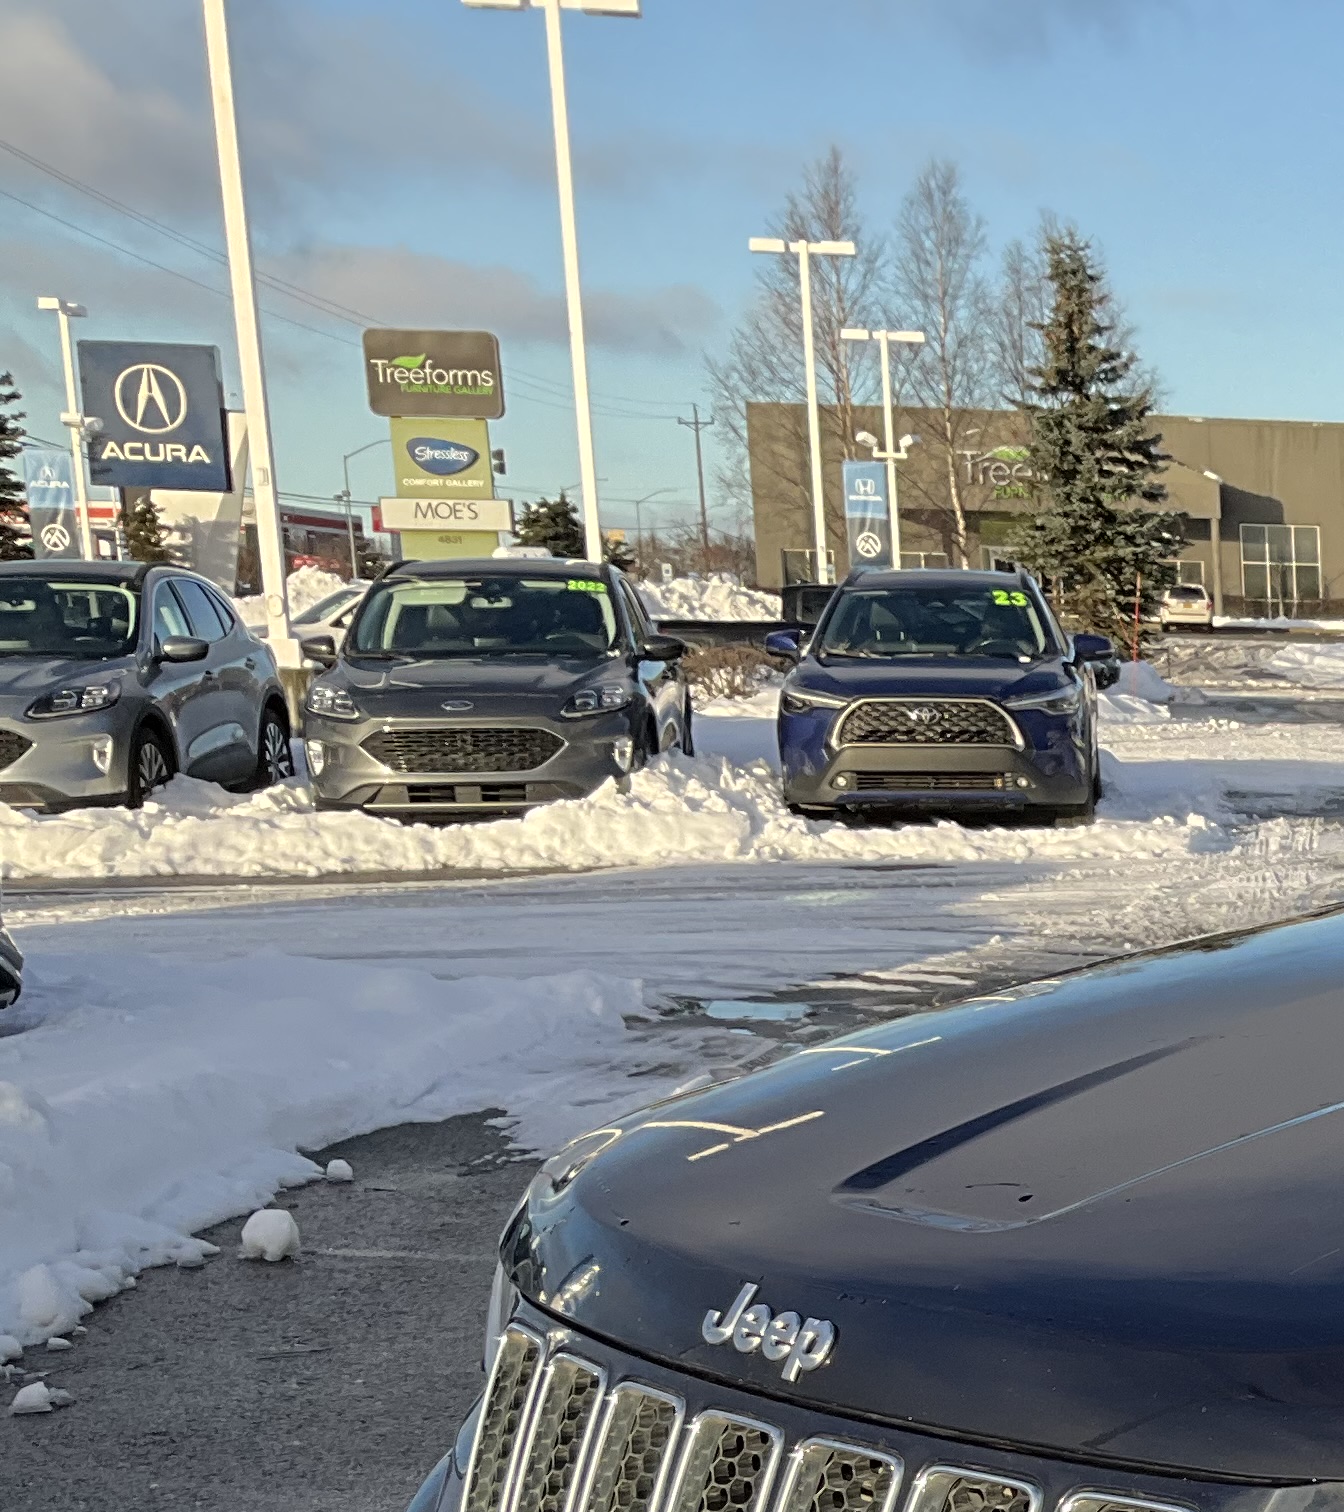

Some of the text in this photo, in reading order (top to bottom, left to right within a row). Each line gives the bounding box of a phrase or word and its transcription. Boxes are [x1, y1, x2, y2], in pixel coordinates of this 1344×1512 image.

[370, 360, 494, 386] Treeforms
[101, 441, 212, 464] ACURA
[414, 447, 471, 462] Stressless
[29, 480, 70, 488] ACURA
[402, 478, 485, 488] COMFORT GALLERY
[414, 502, 479, 520] MOE'S
[567, 580, 606, 592] 2022
[992, 590, 1028, 606] 23
[702, 1282, 836, 1382] Jeep
